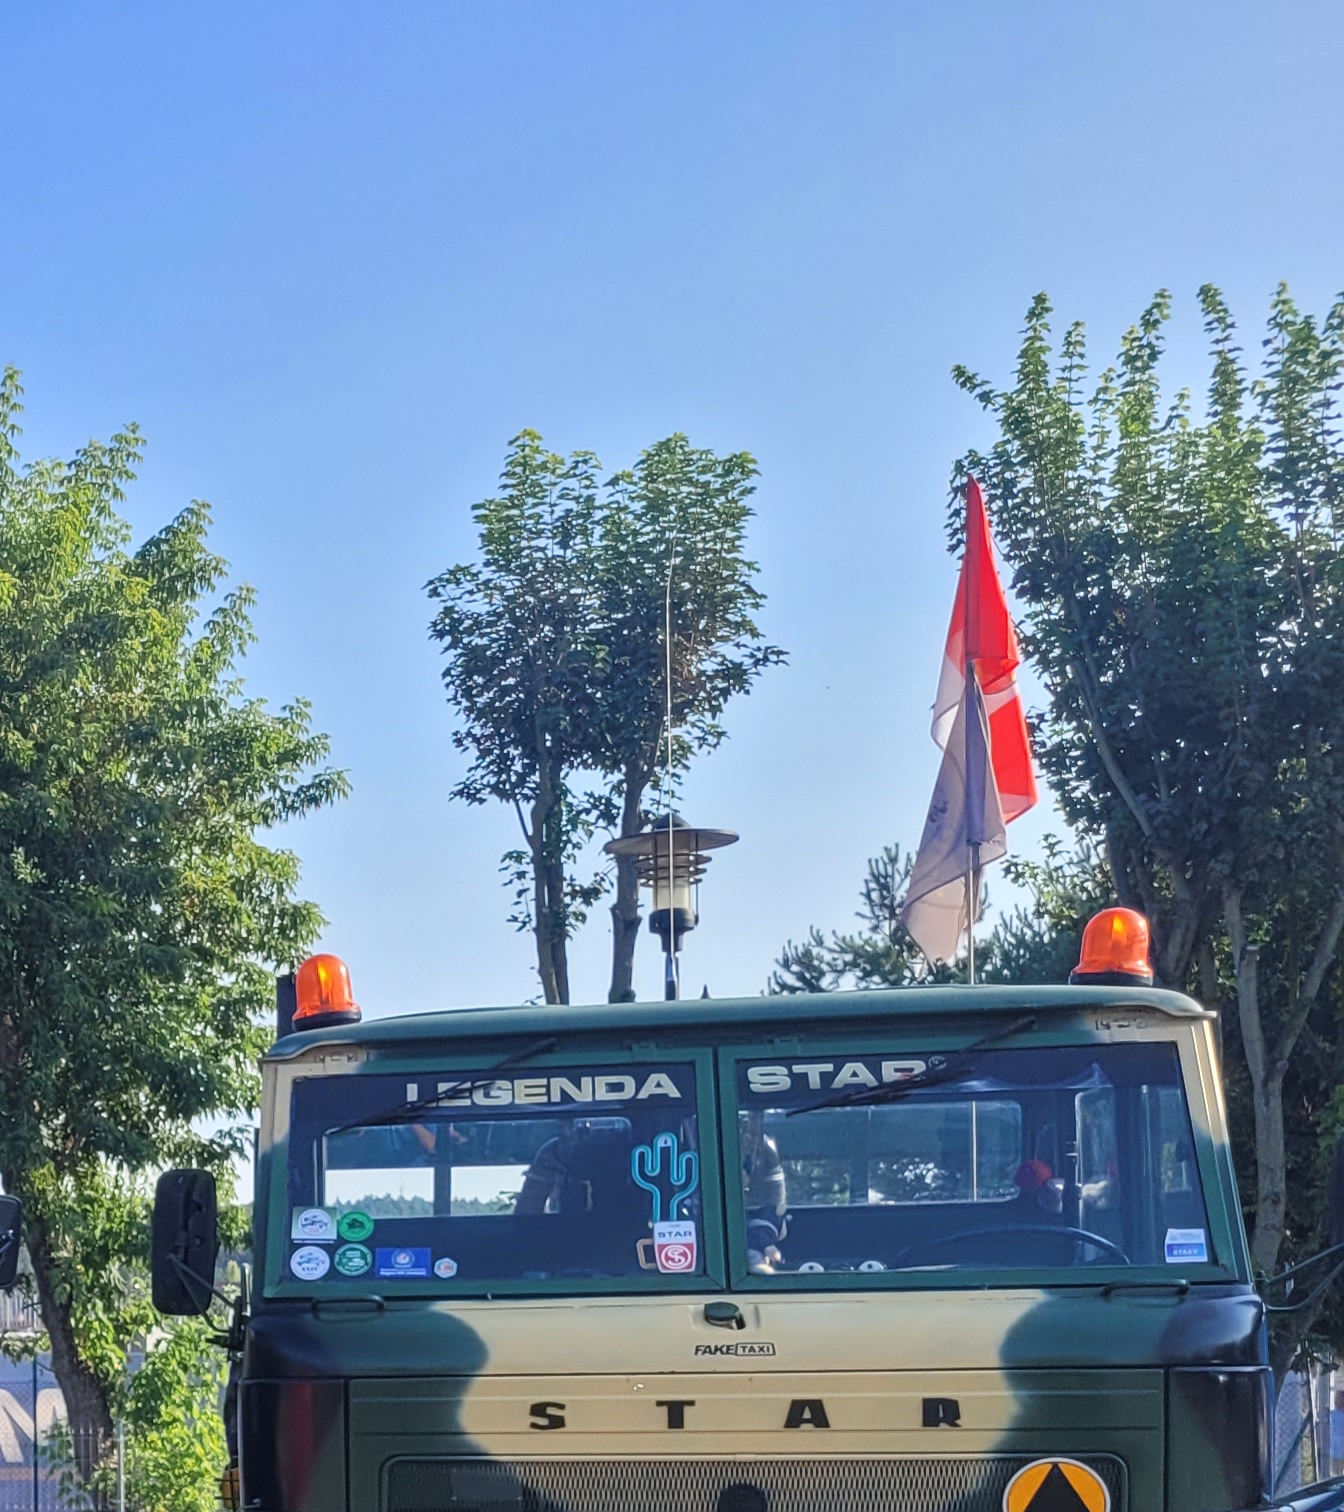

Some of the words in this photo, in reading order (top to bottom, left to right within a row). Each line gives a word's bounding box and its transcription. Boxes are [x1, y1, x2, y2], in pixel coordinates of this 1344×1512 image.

[658, 1230, 692, 1238] STAR
[694, 1343, 736, 1356] FAKE
[740, 1344, 771, 1354] TAXI
[529, 1398, 962, 1430] STAR
